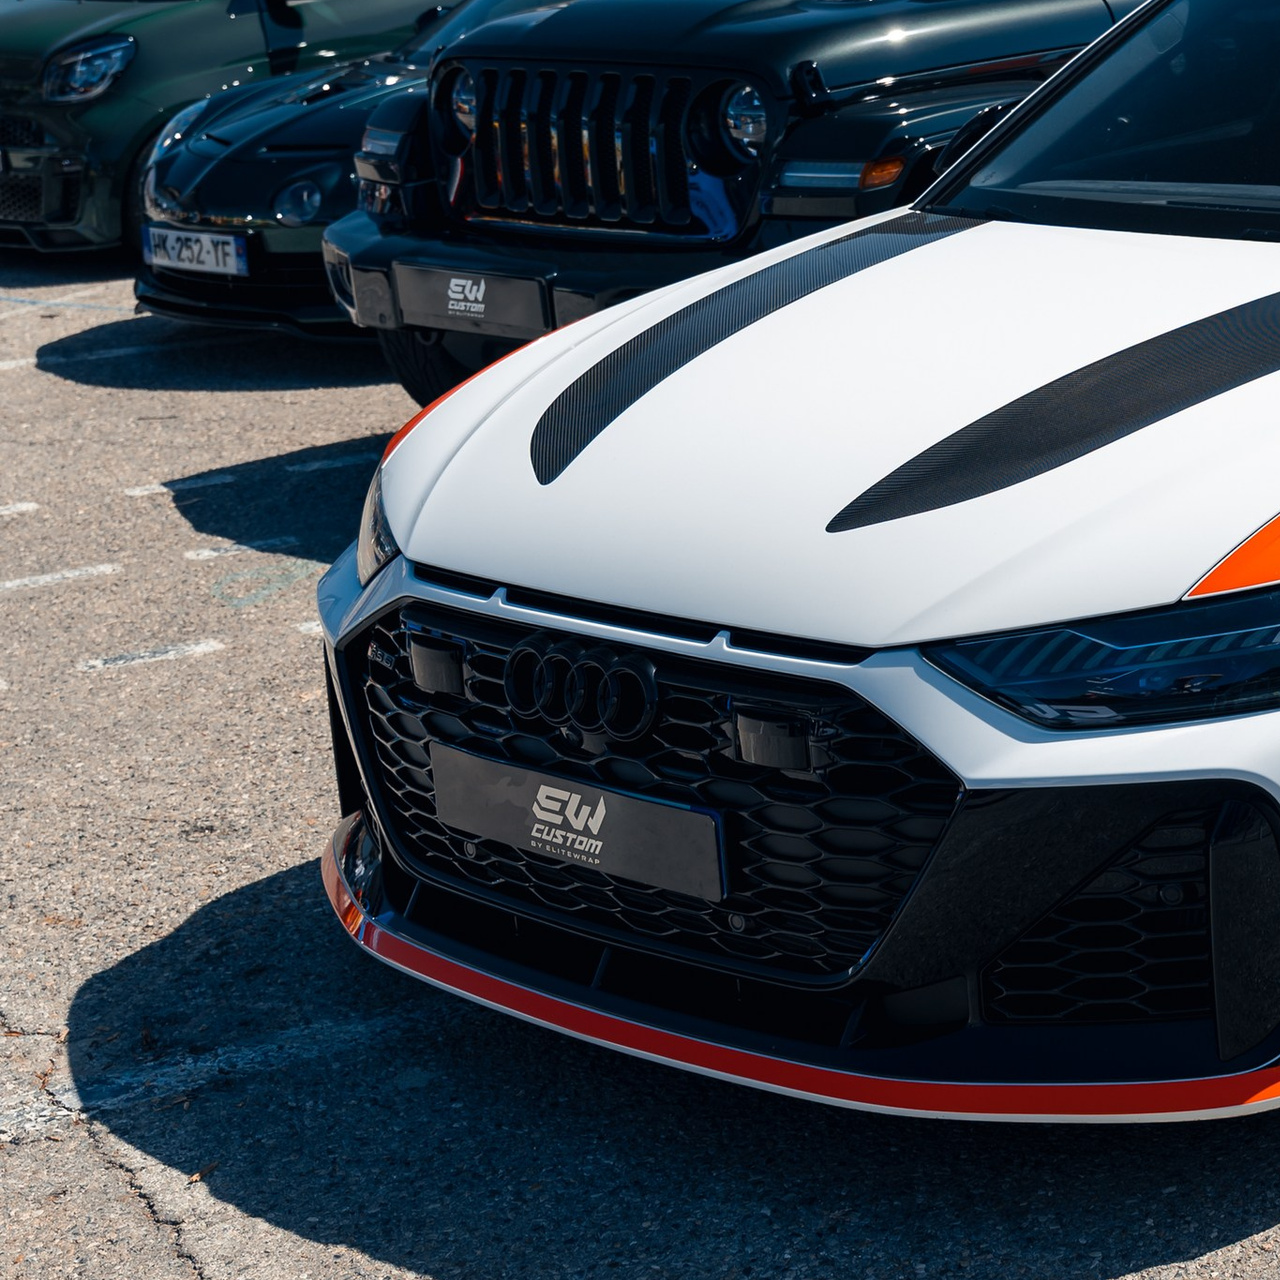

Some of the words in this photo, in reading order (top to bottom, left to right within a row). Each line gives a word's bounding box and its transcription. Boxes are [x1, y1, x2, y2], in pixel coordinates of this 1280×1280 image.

[448, 300, 485, 313] CUSTOM
[531, 823, 603, 855] CUSTOM
[530, 840, 543, 849] BY
[545, 844, 601, 866] ELITEWRAP
